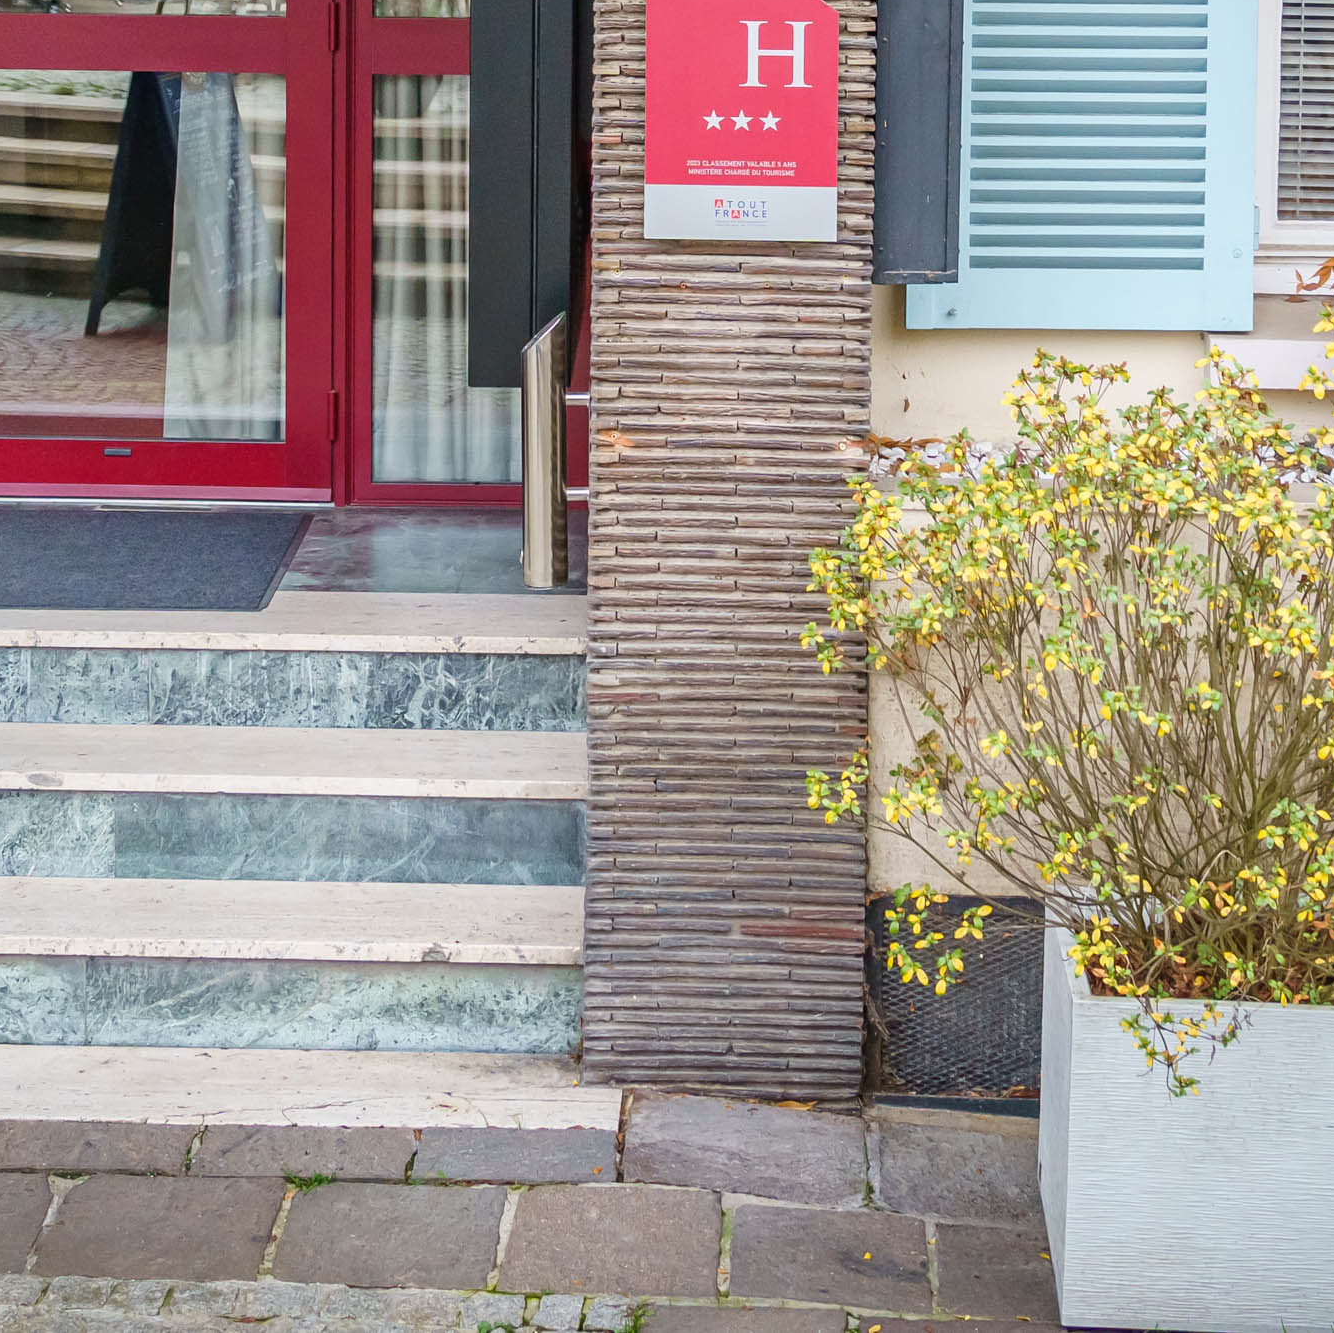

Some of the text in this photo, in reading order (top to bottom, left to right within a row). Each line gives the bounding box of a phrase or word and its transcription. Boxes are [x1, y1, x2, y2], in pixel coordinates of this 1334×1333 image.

[739, 20, 814, 88] H
[762, 169, 796, 177] TOURISME
[715, 209, 768, 218] FRANCE
